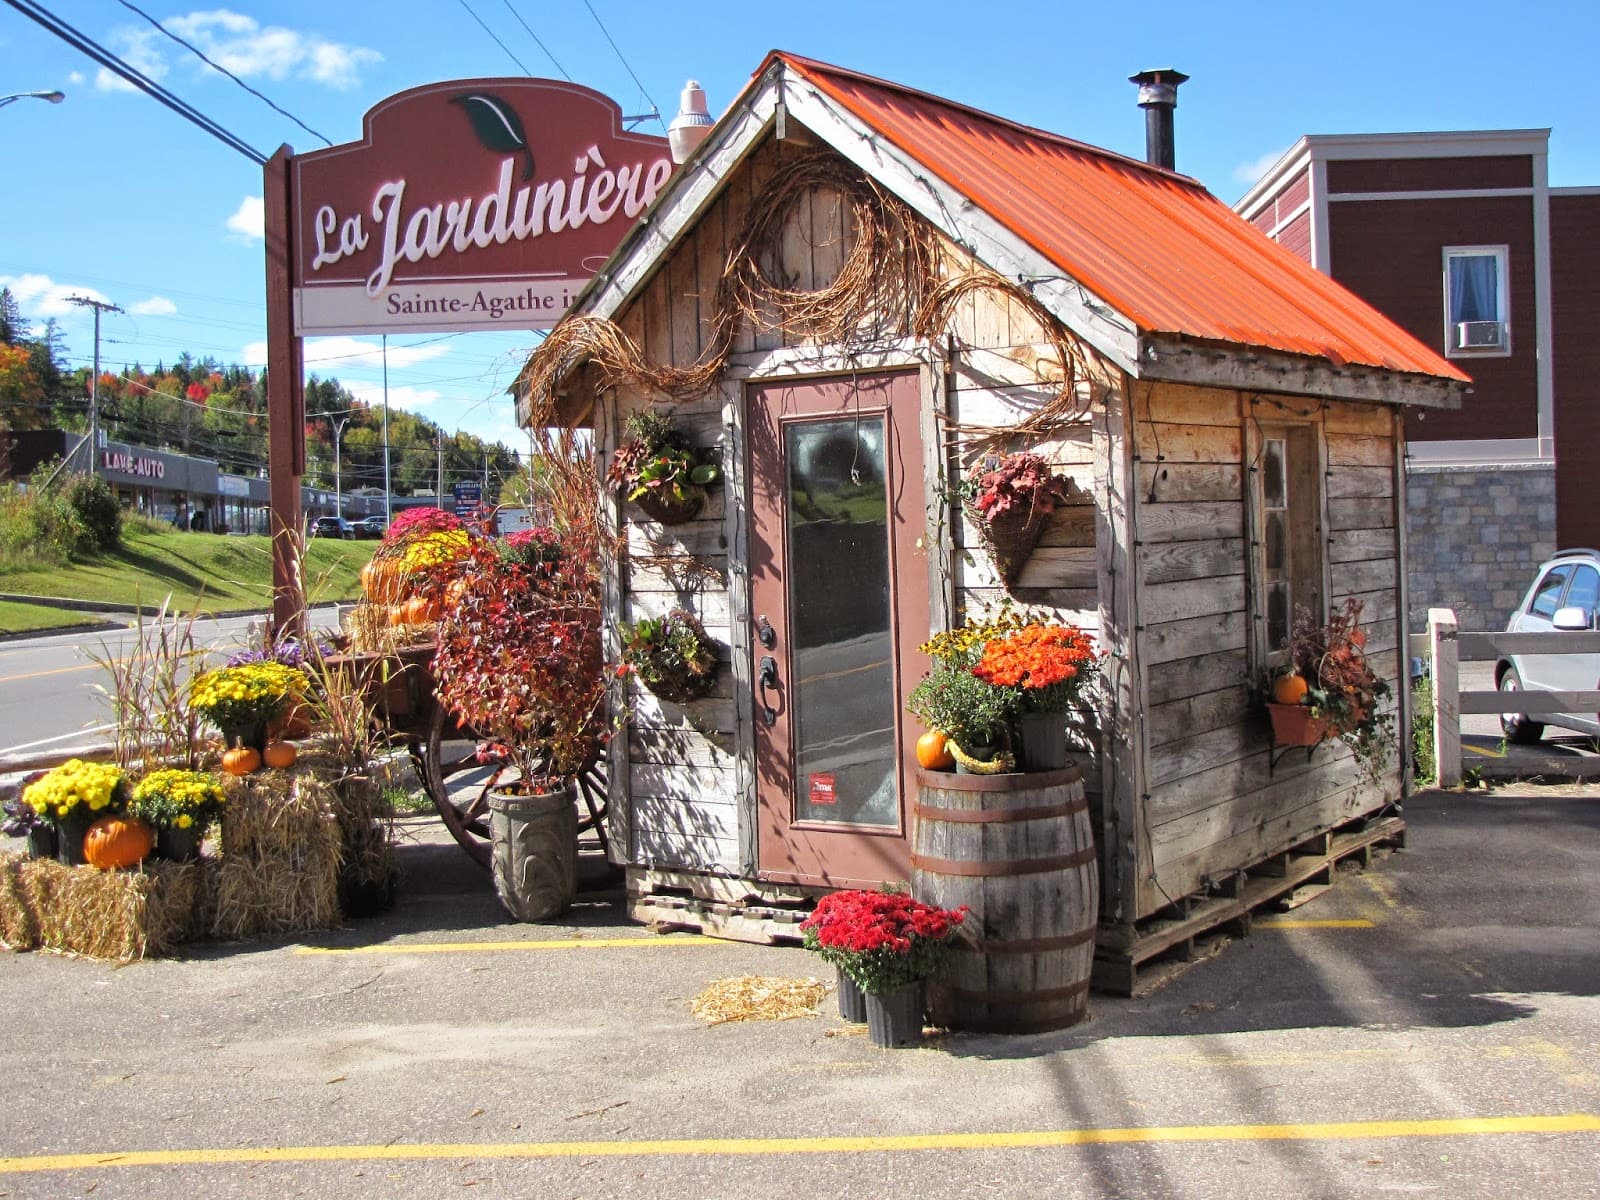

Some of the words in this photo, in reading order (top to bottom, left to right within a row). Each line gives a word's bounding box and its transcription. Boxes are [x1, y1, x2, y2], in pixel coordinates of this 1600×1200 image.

[312, 205, 370, 270] La
[366, 144, 671, 298] Jardinière
[387, 288, 554, 319] Sainte-Agathe
[102, 451, 165, 479] LAVE-AUTO
